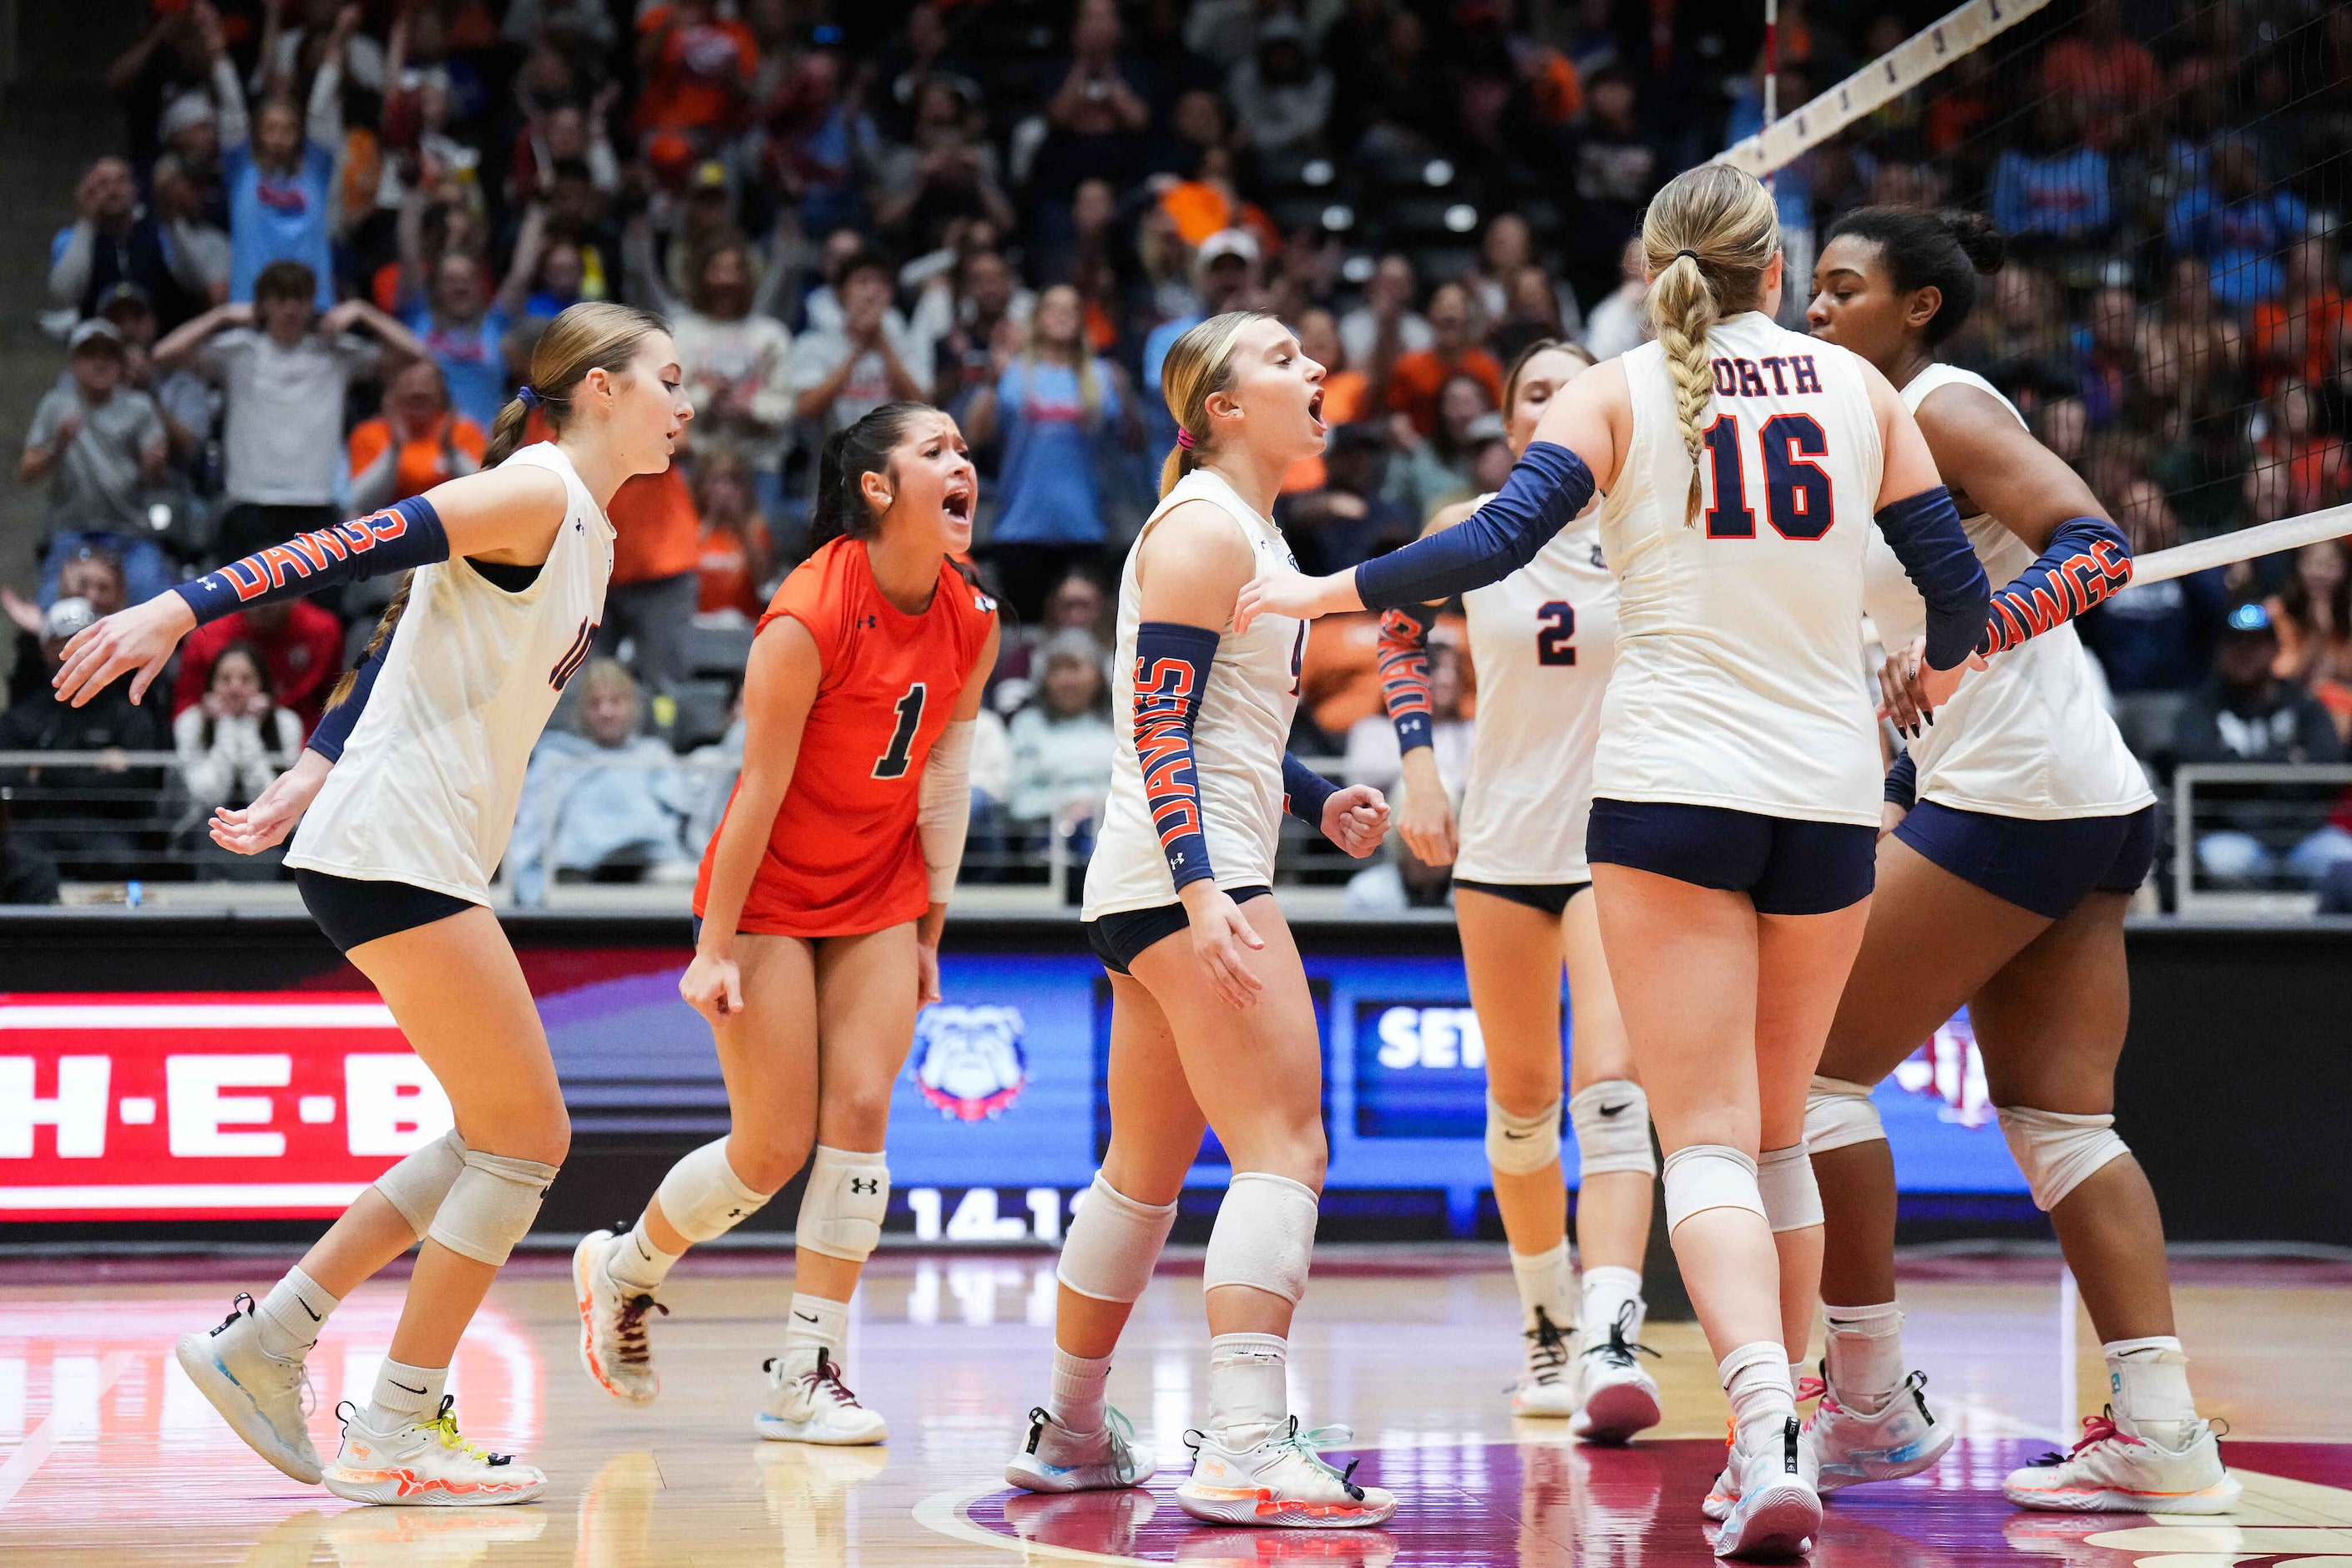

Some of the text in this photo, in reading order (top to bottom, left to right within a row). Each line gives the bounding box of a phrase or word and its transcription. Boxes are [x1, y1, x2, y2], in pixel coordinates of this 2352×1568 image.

[1707, 355, 1823, 397] ORTH
[1702, 412, 1834, 541] 16
[215, 508, 407, 602] DAWGS
[1537, 601, 1576, 666] 2
[870, 682, 927, 780] 1
[1133, 656, 1201, 849] DAWGS
[1378, 1006, 1486, 1070] SET
